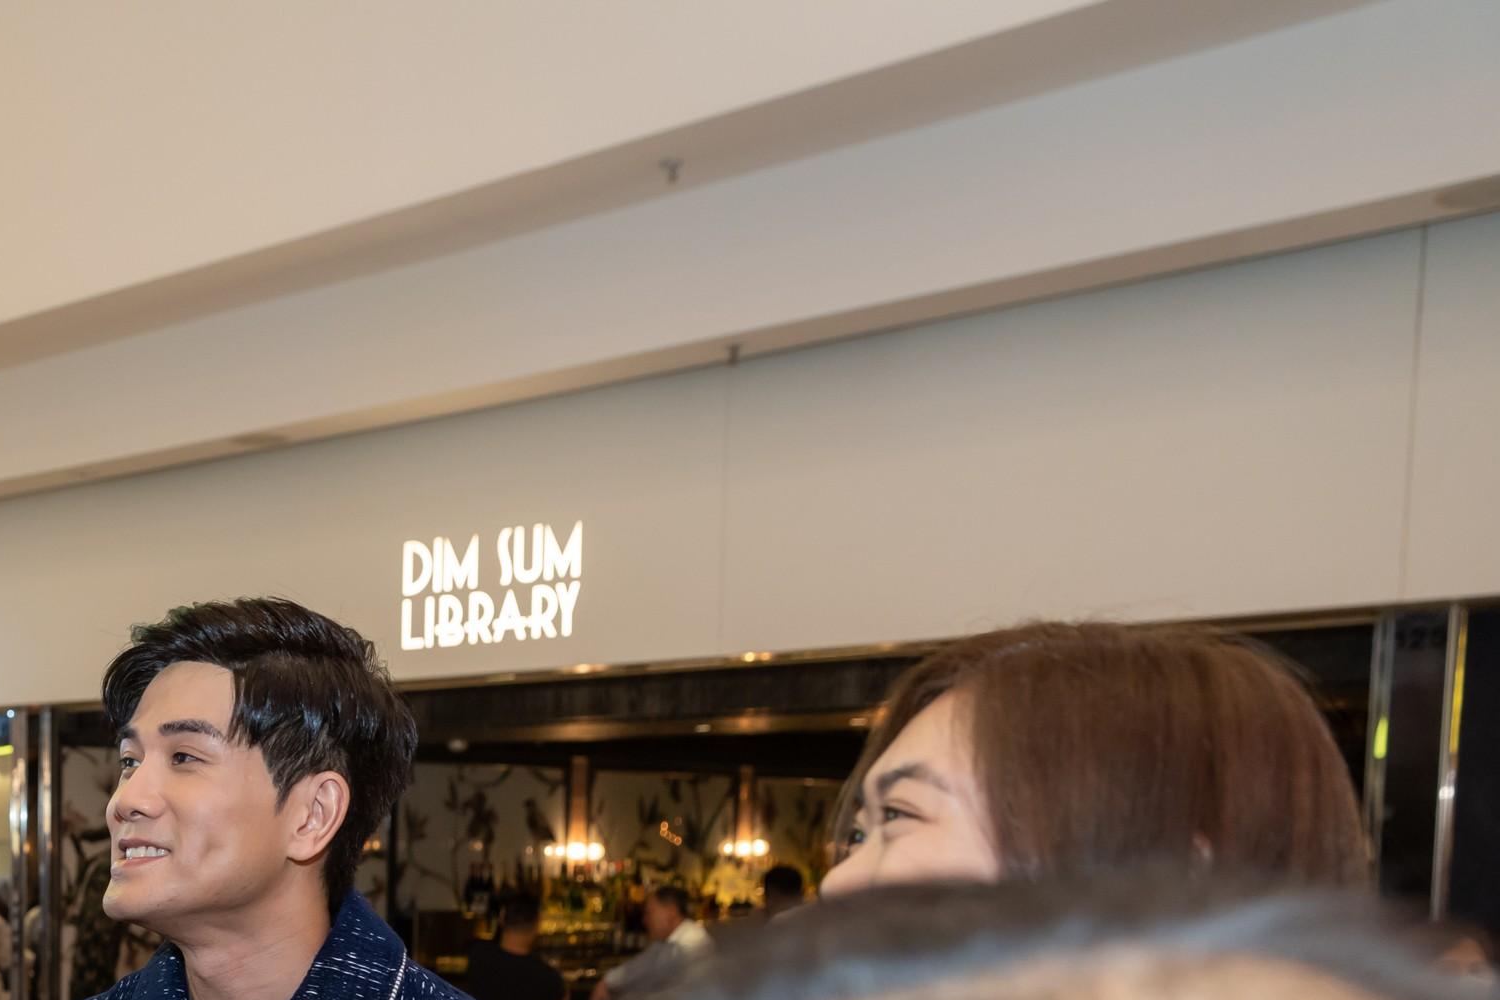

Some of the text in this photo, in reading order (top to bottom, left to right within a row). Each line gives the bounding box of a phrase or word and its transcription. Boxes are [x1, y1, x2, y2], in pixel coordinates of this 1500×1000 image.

[402, 520, 583, 597] DIM SUM
[401, 580, 581, 651] LIBRARY
